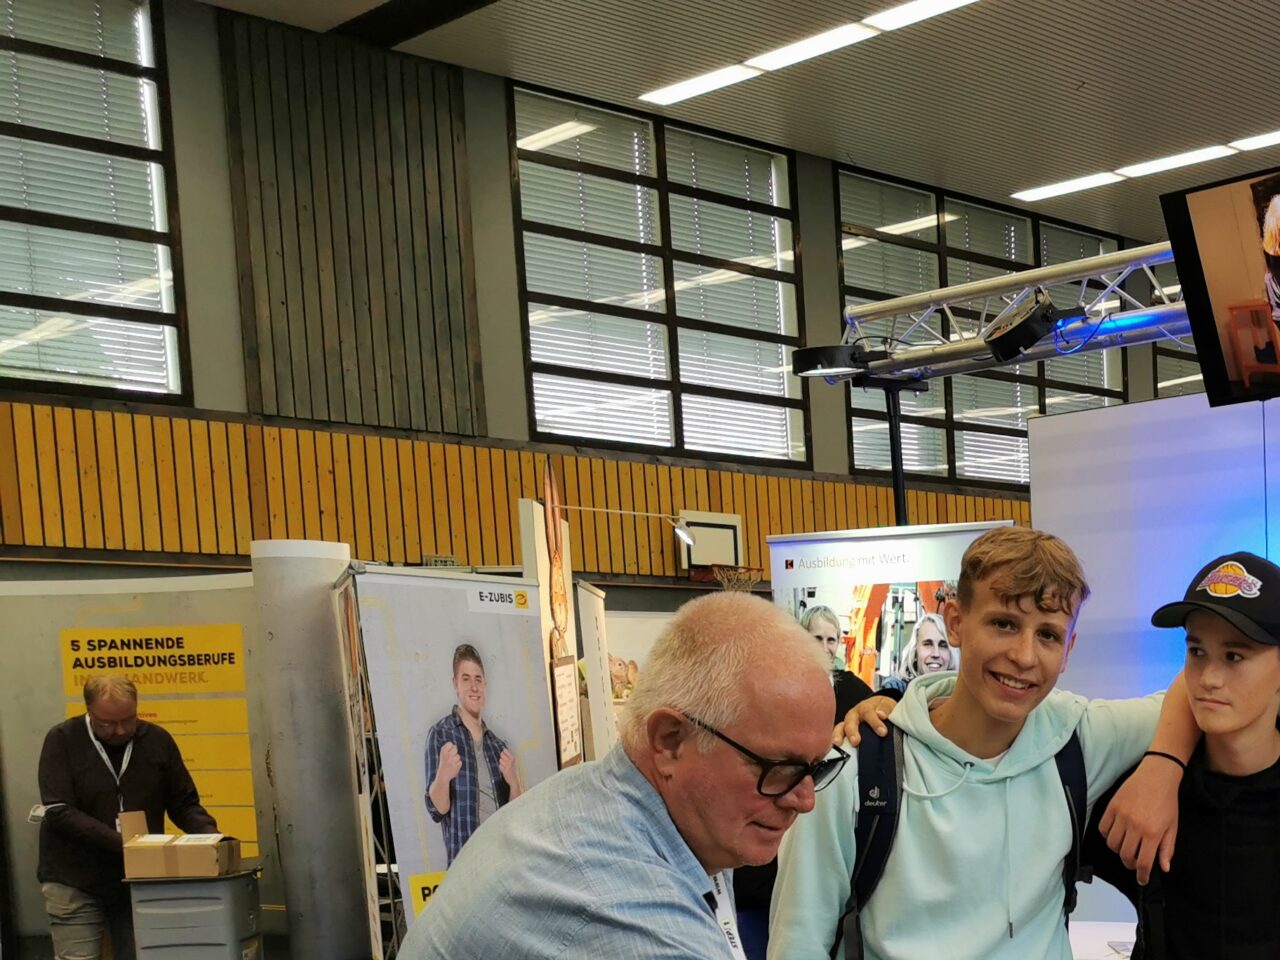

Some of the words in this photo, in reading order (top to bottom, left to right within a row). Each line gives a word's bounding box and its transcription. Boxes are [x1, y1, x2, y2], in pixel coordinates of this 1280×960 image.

[858, 555, 876, 566] mit
[479, 591, 514, 604] E-ZUBIS
[70, 640, 81, 651] 5
[86, 637, 185, 651] SPANNENDE
[72, 652, 236, 669] AUSBILDUNGSBERUFE
